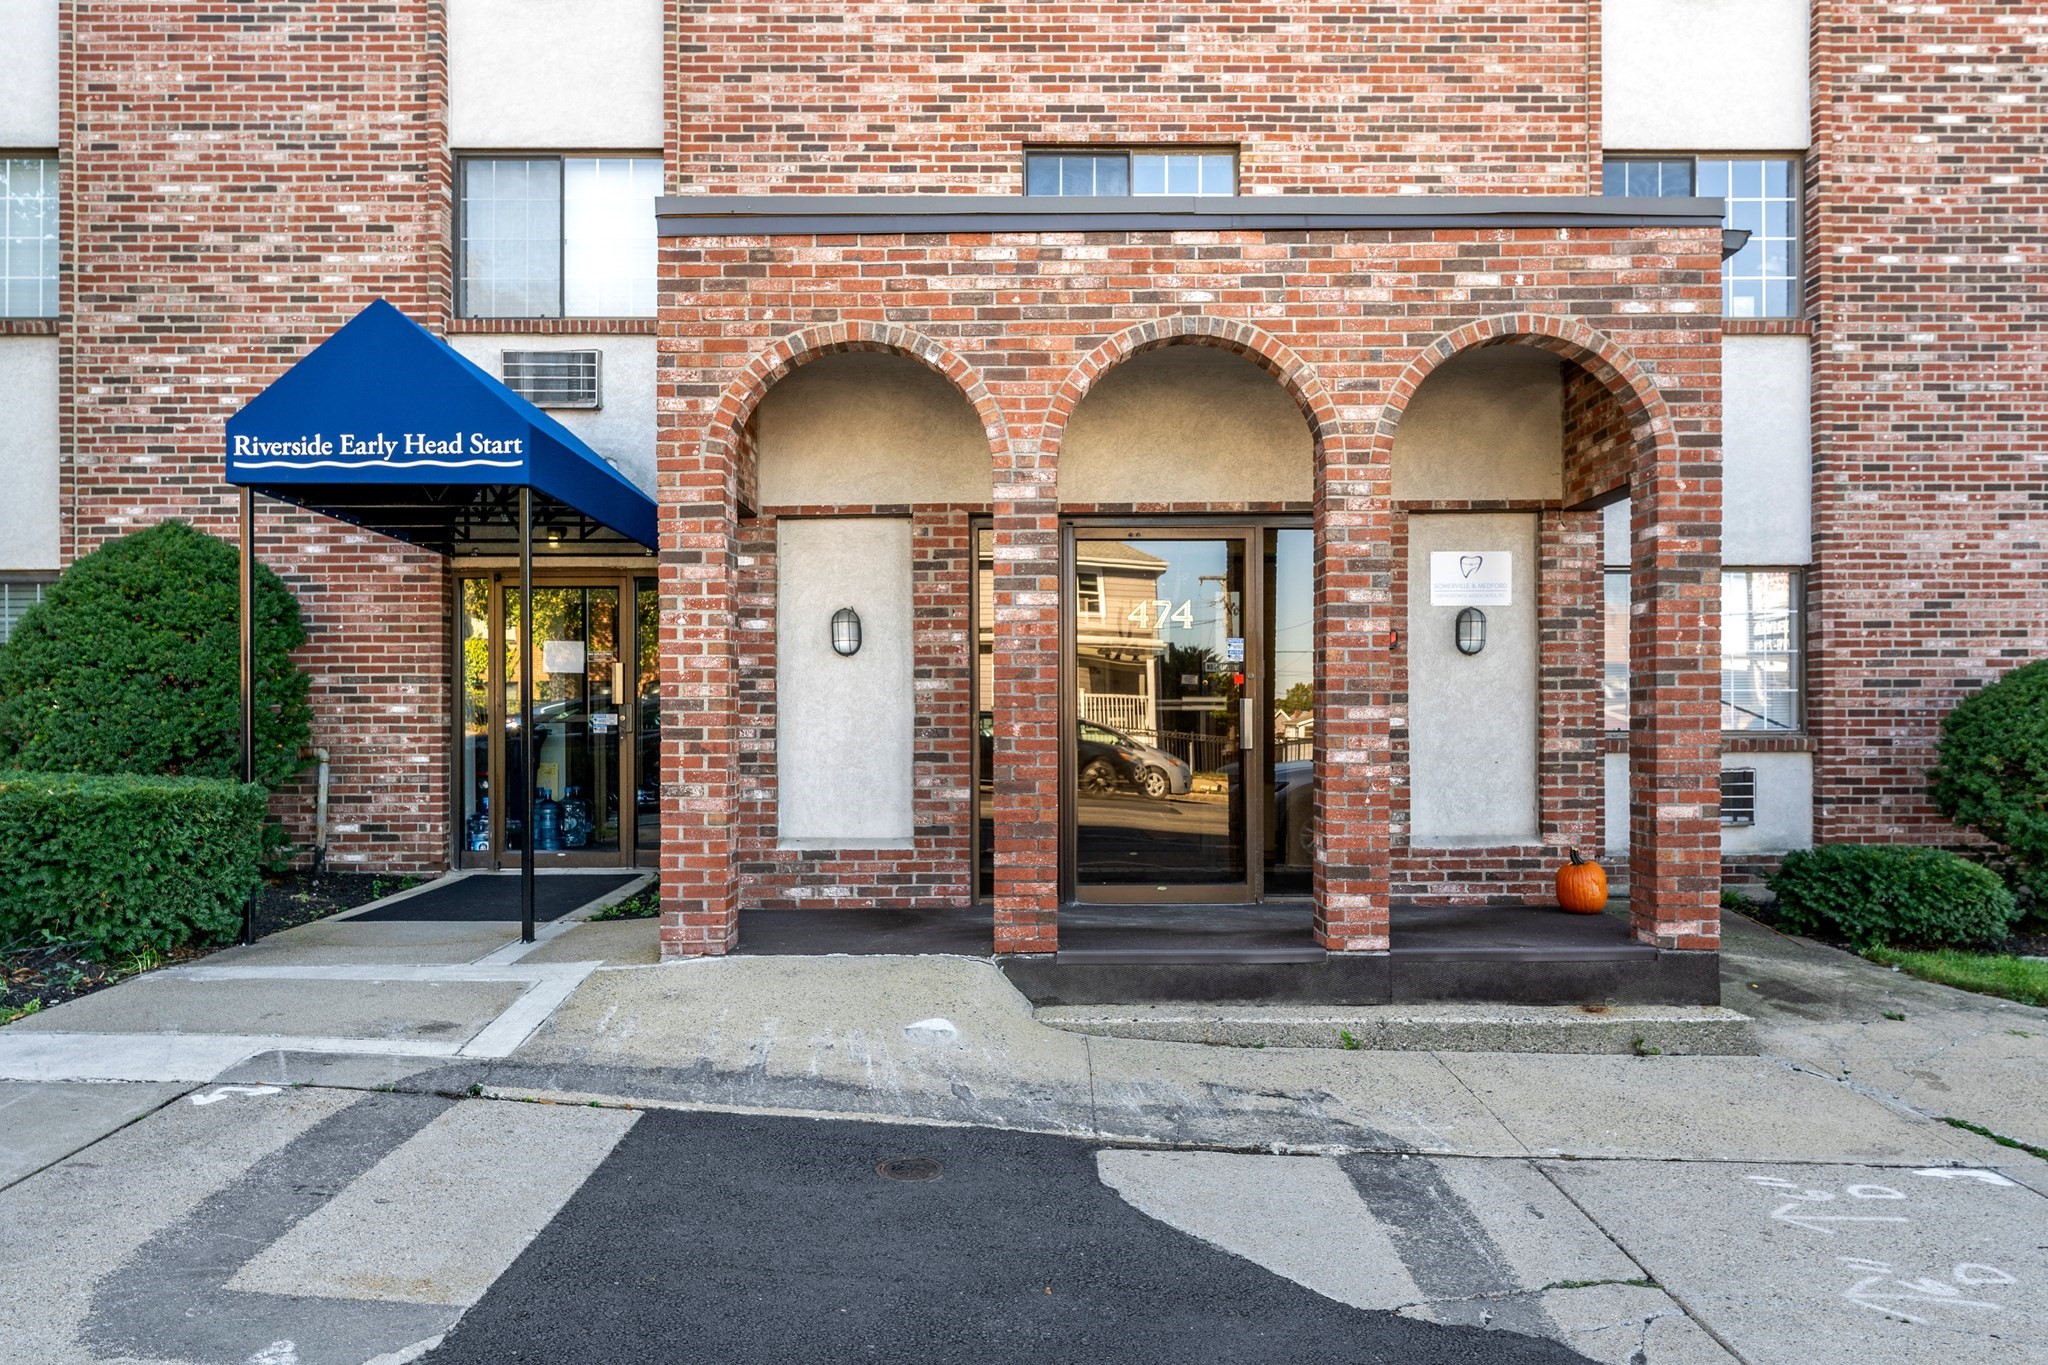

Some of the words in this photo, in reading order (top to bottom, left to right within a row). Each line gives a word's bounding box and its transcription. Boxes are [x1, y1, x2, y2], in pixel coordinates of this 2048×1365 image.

[234, 434, 332, 455] Riverside
[340, 433, 398, 461] Early
[404, 432, 463, 454] Head
[470, 433, 522, 454] Start
[1127, 598, 1194, 629] 474
